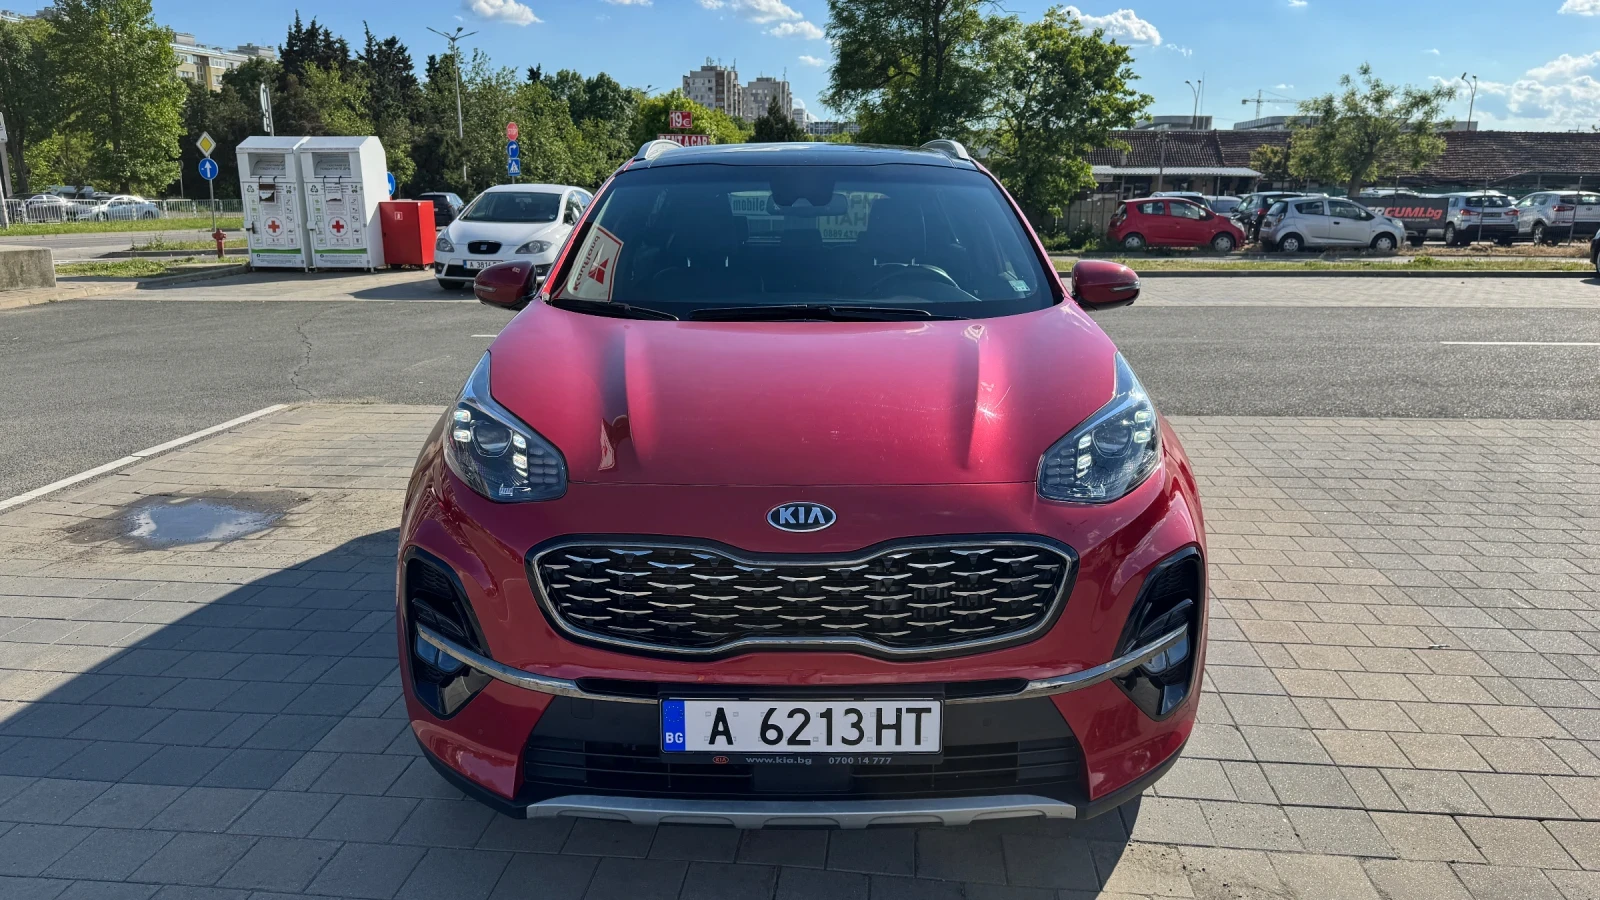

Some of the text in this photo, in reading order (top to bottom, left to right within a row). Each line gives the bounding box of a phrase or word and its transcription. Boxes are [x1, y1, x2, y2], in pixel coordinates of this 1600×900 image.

[691, 136, 708, 147] CAR
[733, 197, 765, 212] mobile
[779, 507, 826, 524] KIA
[708, 707, 734, 745] A
[665, 732, 684, 744] BG
[745, 757, 892, 765] www.kia.bg 0700 14 777
